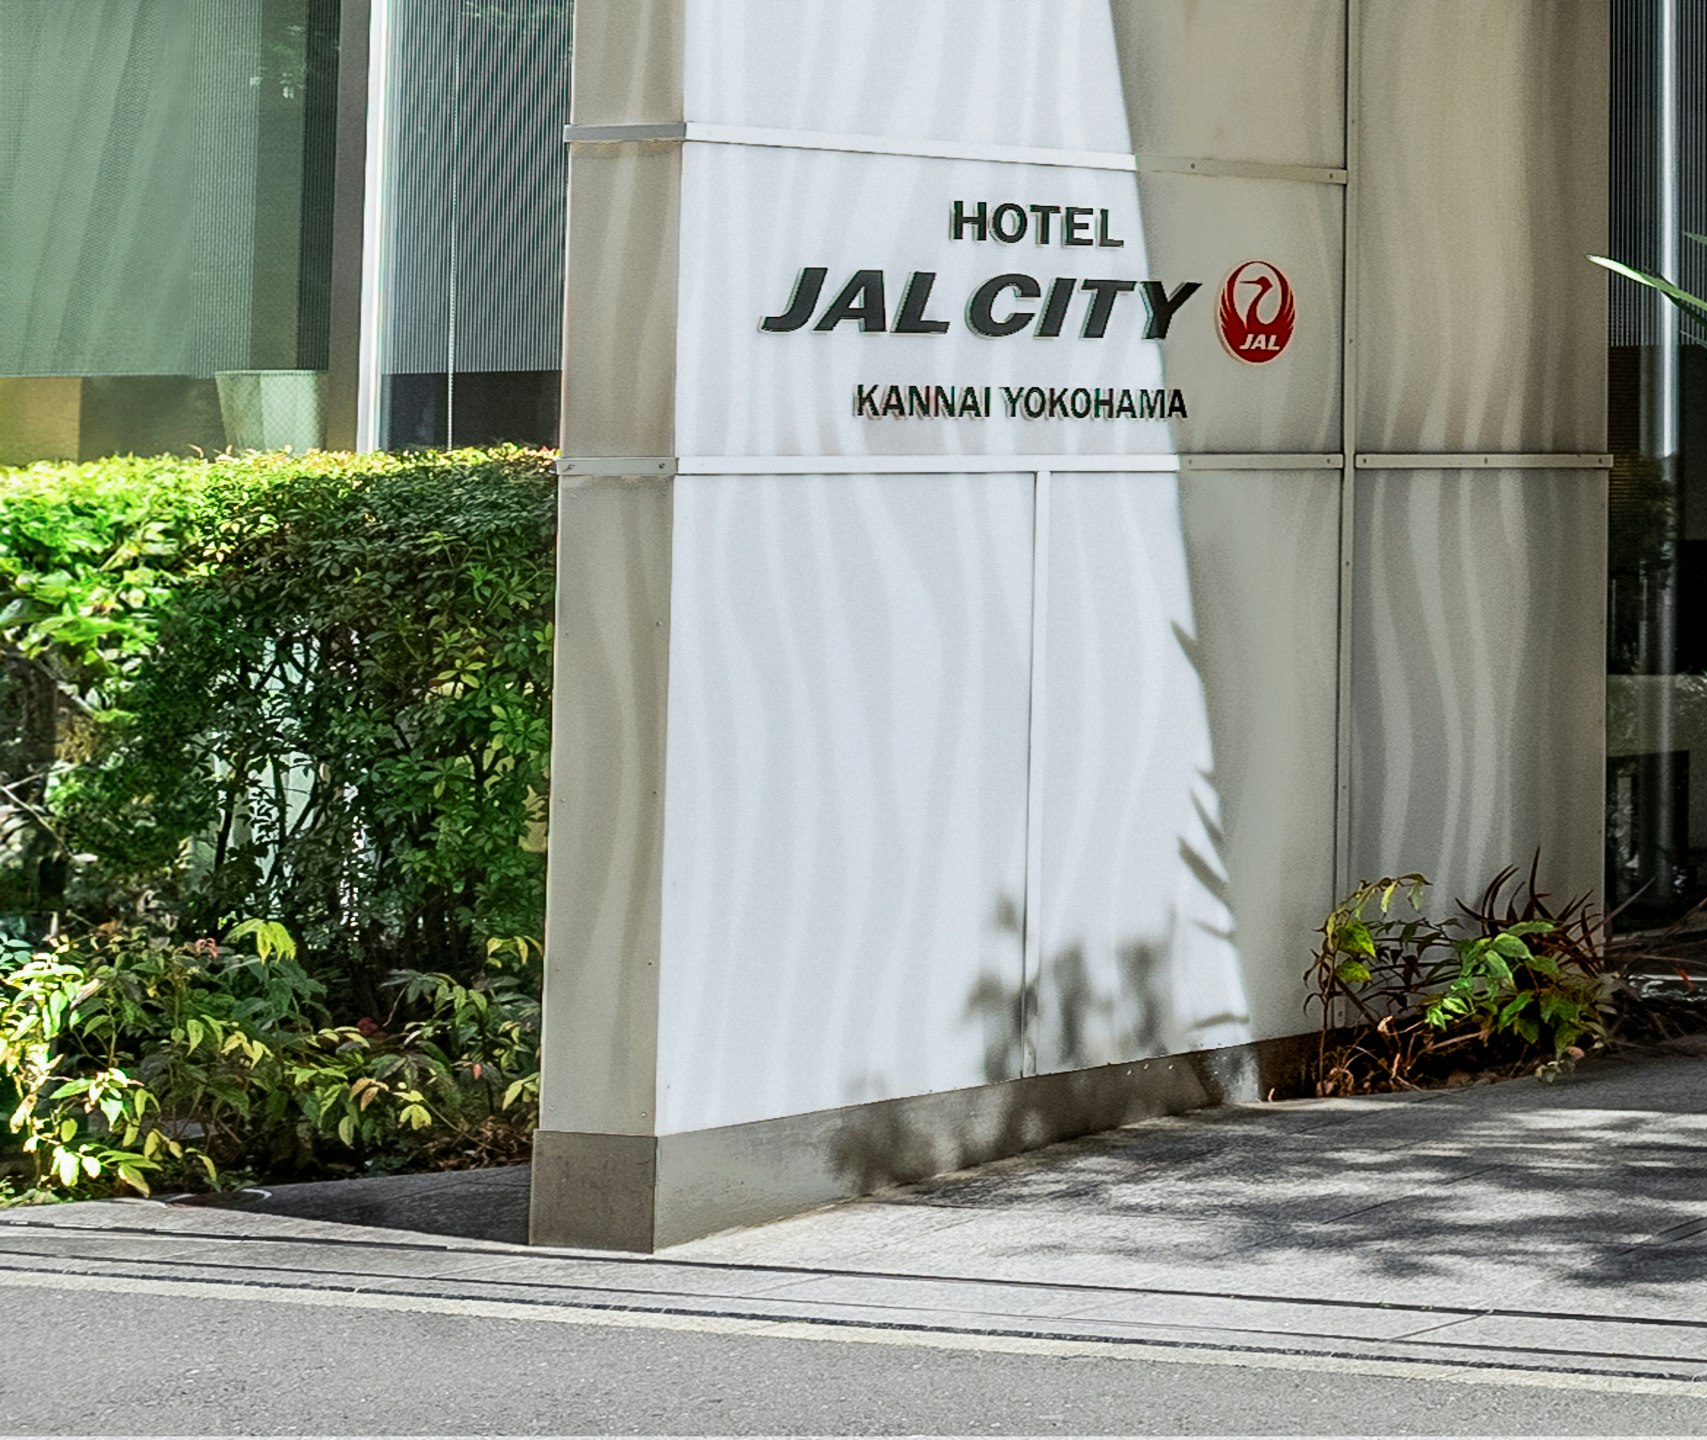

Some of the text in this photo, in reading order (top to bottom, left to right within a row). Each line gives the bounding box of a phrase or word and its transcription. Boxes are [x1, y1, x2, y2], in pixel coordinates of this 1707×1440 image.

[951, 200, 1125, 248] HOTEL
[1239, 333, 1281, 351] JAL
[855, 383, 1189, 420] KANNAI YOKOHAMA
